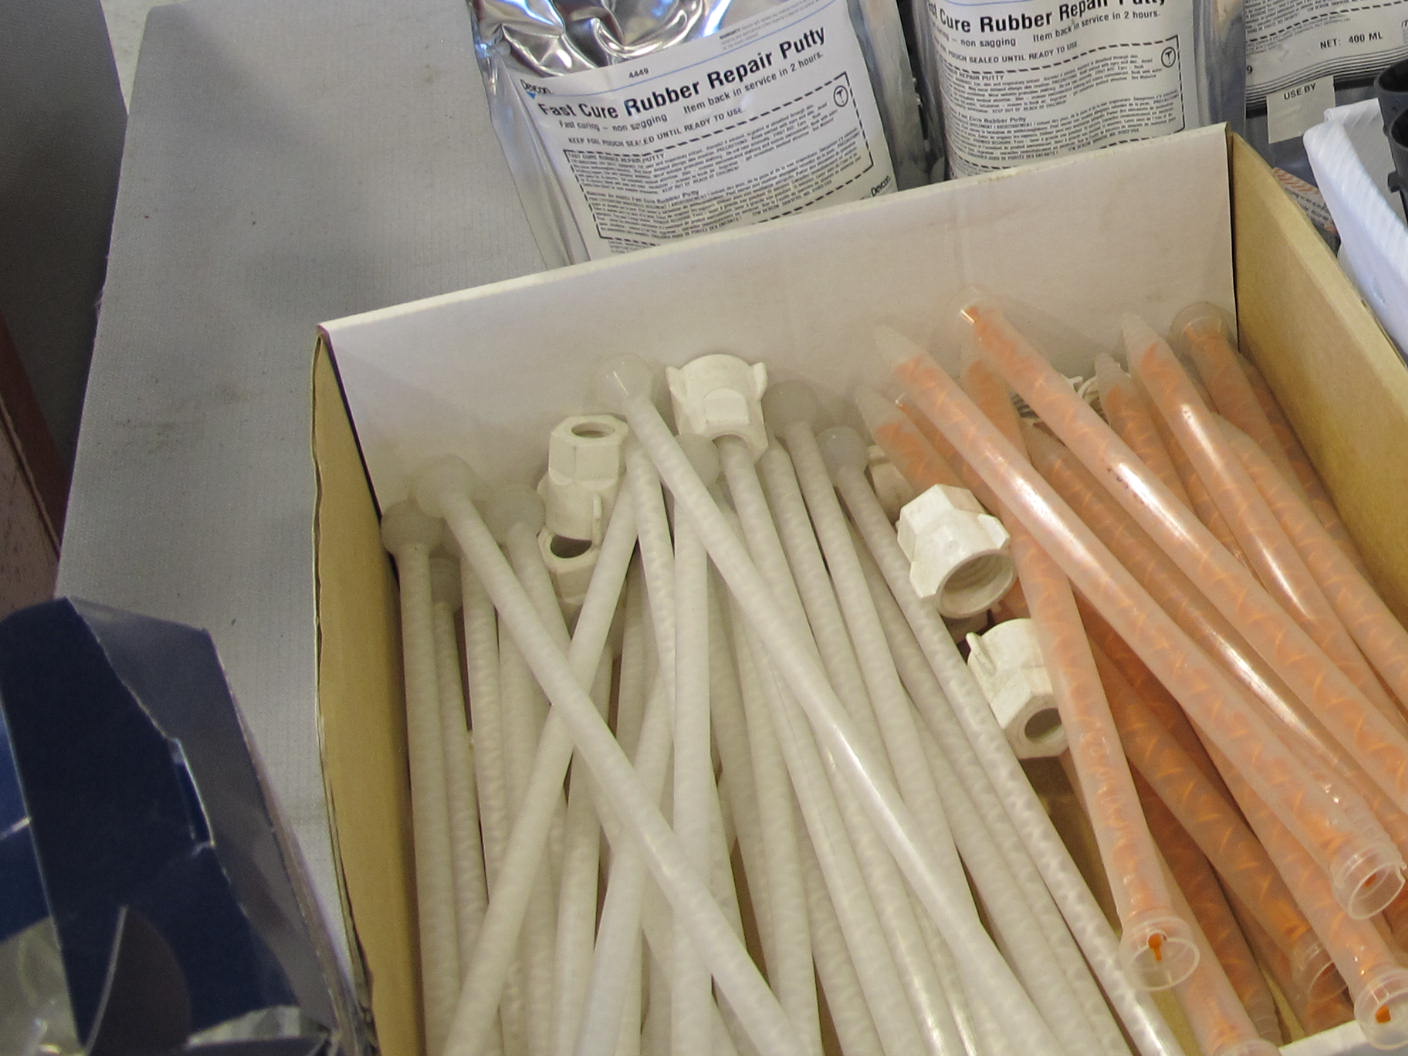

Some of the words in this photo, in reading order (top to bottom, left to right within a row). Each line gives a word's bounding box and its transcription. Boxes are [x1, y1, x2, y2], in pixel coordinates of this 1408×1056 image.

[940, 7, 972, 33] Cure
[979, 11, 1053, 33] Rubber
[960, 38, 977, 47] non
[979, 37, 1017, 48] sagging
[1033, 31, 1053, 43] Item
[1055, 26, 1072, 38] back
[1080, 13, 1110, 28] service
[1112, 11, 1121, 20] in
[1123, 10, 1130, 20] 2
[1132, 9, 1161, 20] hours.
[1347, 34, 1366, 45] 400
[1368, 31, 1384, 41] ML
[968, 55, 999, 63] SEALED
[1001, 54, 1026, 62] UNTIL
[1028, 48, 1054, 60] READY
[1056, 46, 1066, 55] TO
[538, 102, 577, 117] Fast
[577, 102, 619, 119] Cure
[623, 80, 700, 117] Rubber
[707, 51, 774, 90] Repair
[779, 25, 826, 60] Putty
[628, 67, 650, 79] 4449
[611, 123, 629, 132] non
[630, 113, 668, 132] sagging
[683, 101, 706, 115] Item
[707, 92, 730, 107] back
[732, 87, 743, 97] in
[744, 73, 778, 92] service
[779, 66, 789, 77] in
[790, 62, 797, 73] 2
[798, 50, 824, 68] hours.
[1283, 89, 1301, 101] USE
[1303, 82, 1317, 95] BY
[656, 127, 682, 141] UNTIL
[683, 117, 711, 133] READY
[713, 112, 725, 123] TO
